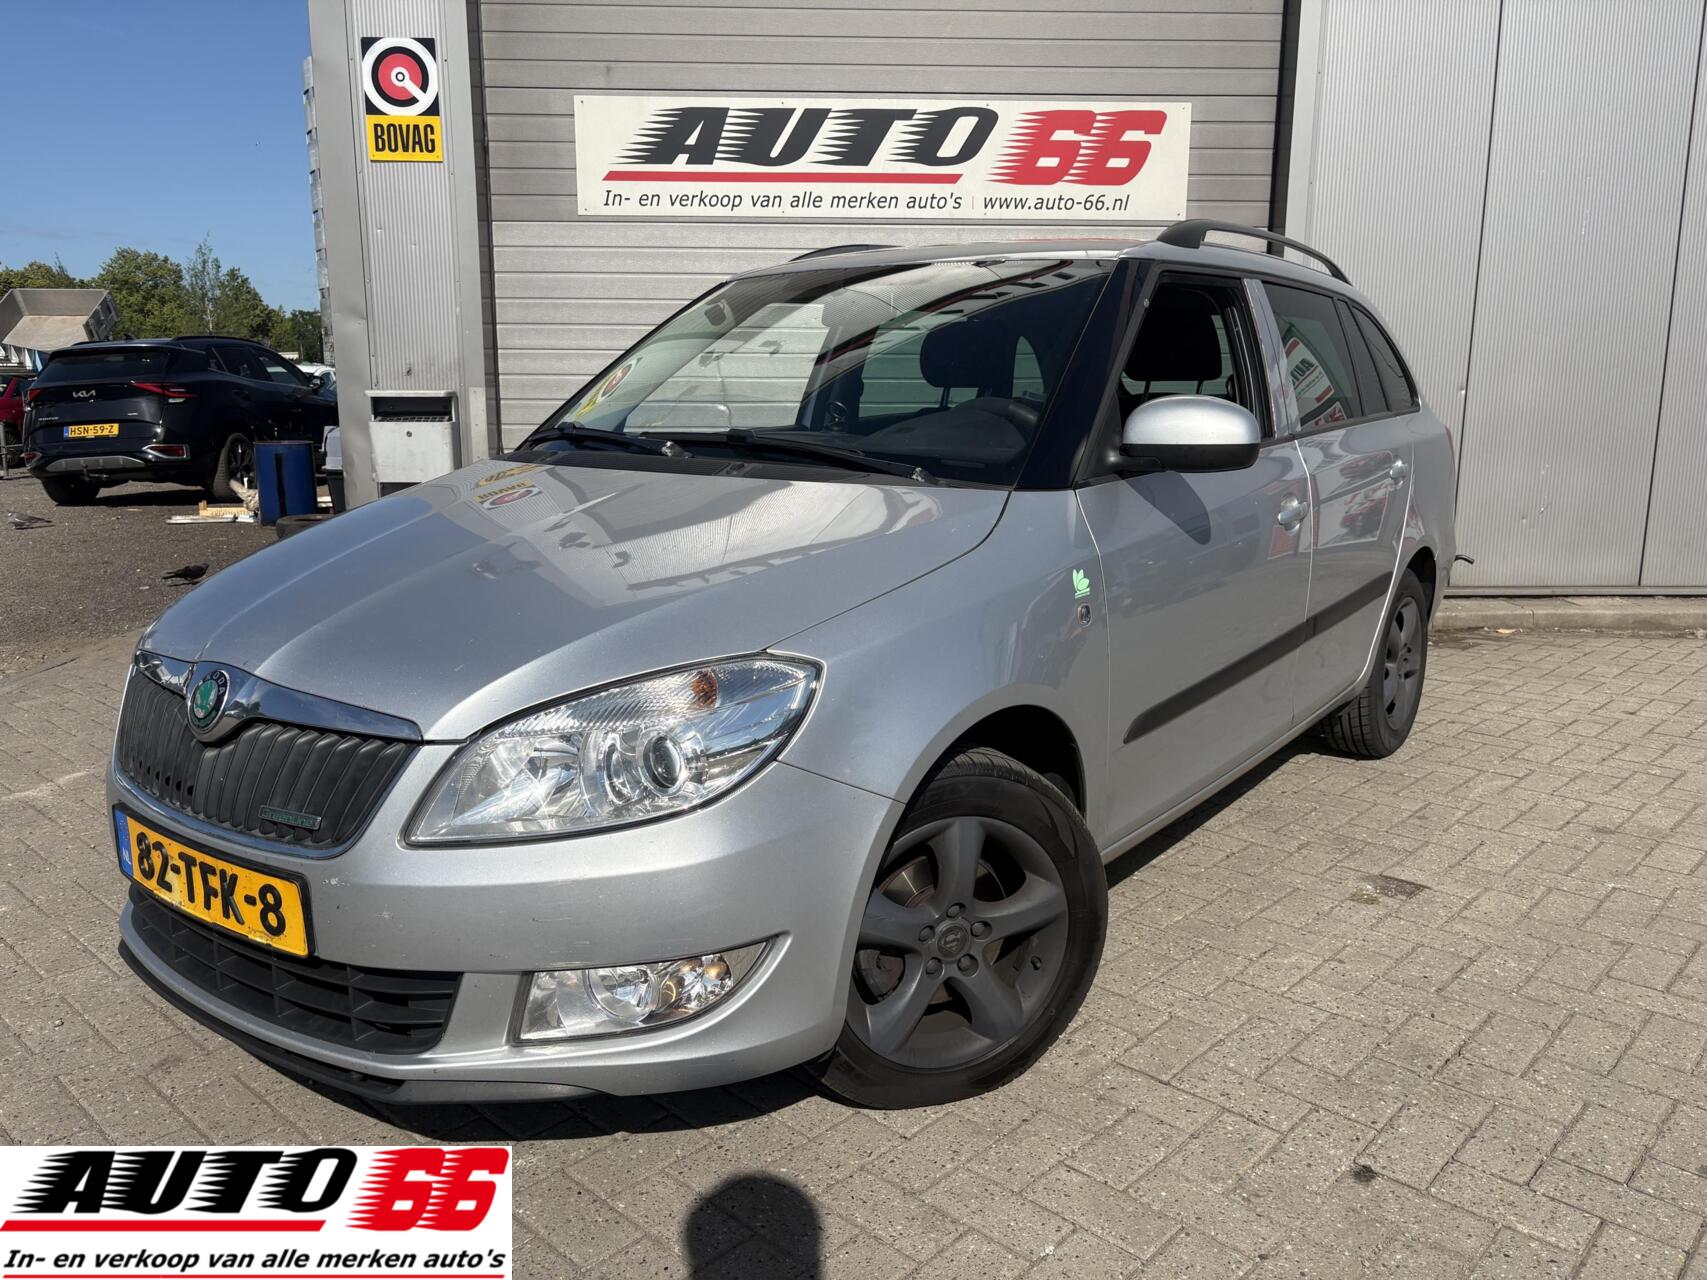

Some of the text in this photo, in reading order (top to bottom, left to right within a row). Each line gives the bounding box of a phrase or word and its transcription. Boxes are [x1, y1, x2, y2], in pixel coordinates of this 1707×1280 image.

[373, 123, 436, 154] BOVAG
[608, 107, 1167, 186] AUTO 66
[604, 189, 1131, 211] In- en verkoop van alle merken auto's www.auto-66.nl
[70, 425, 114, 435] HSN-59-Z
[136, 832, 286, 937] 82-TFK-8
